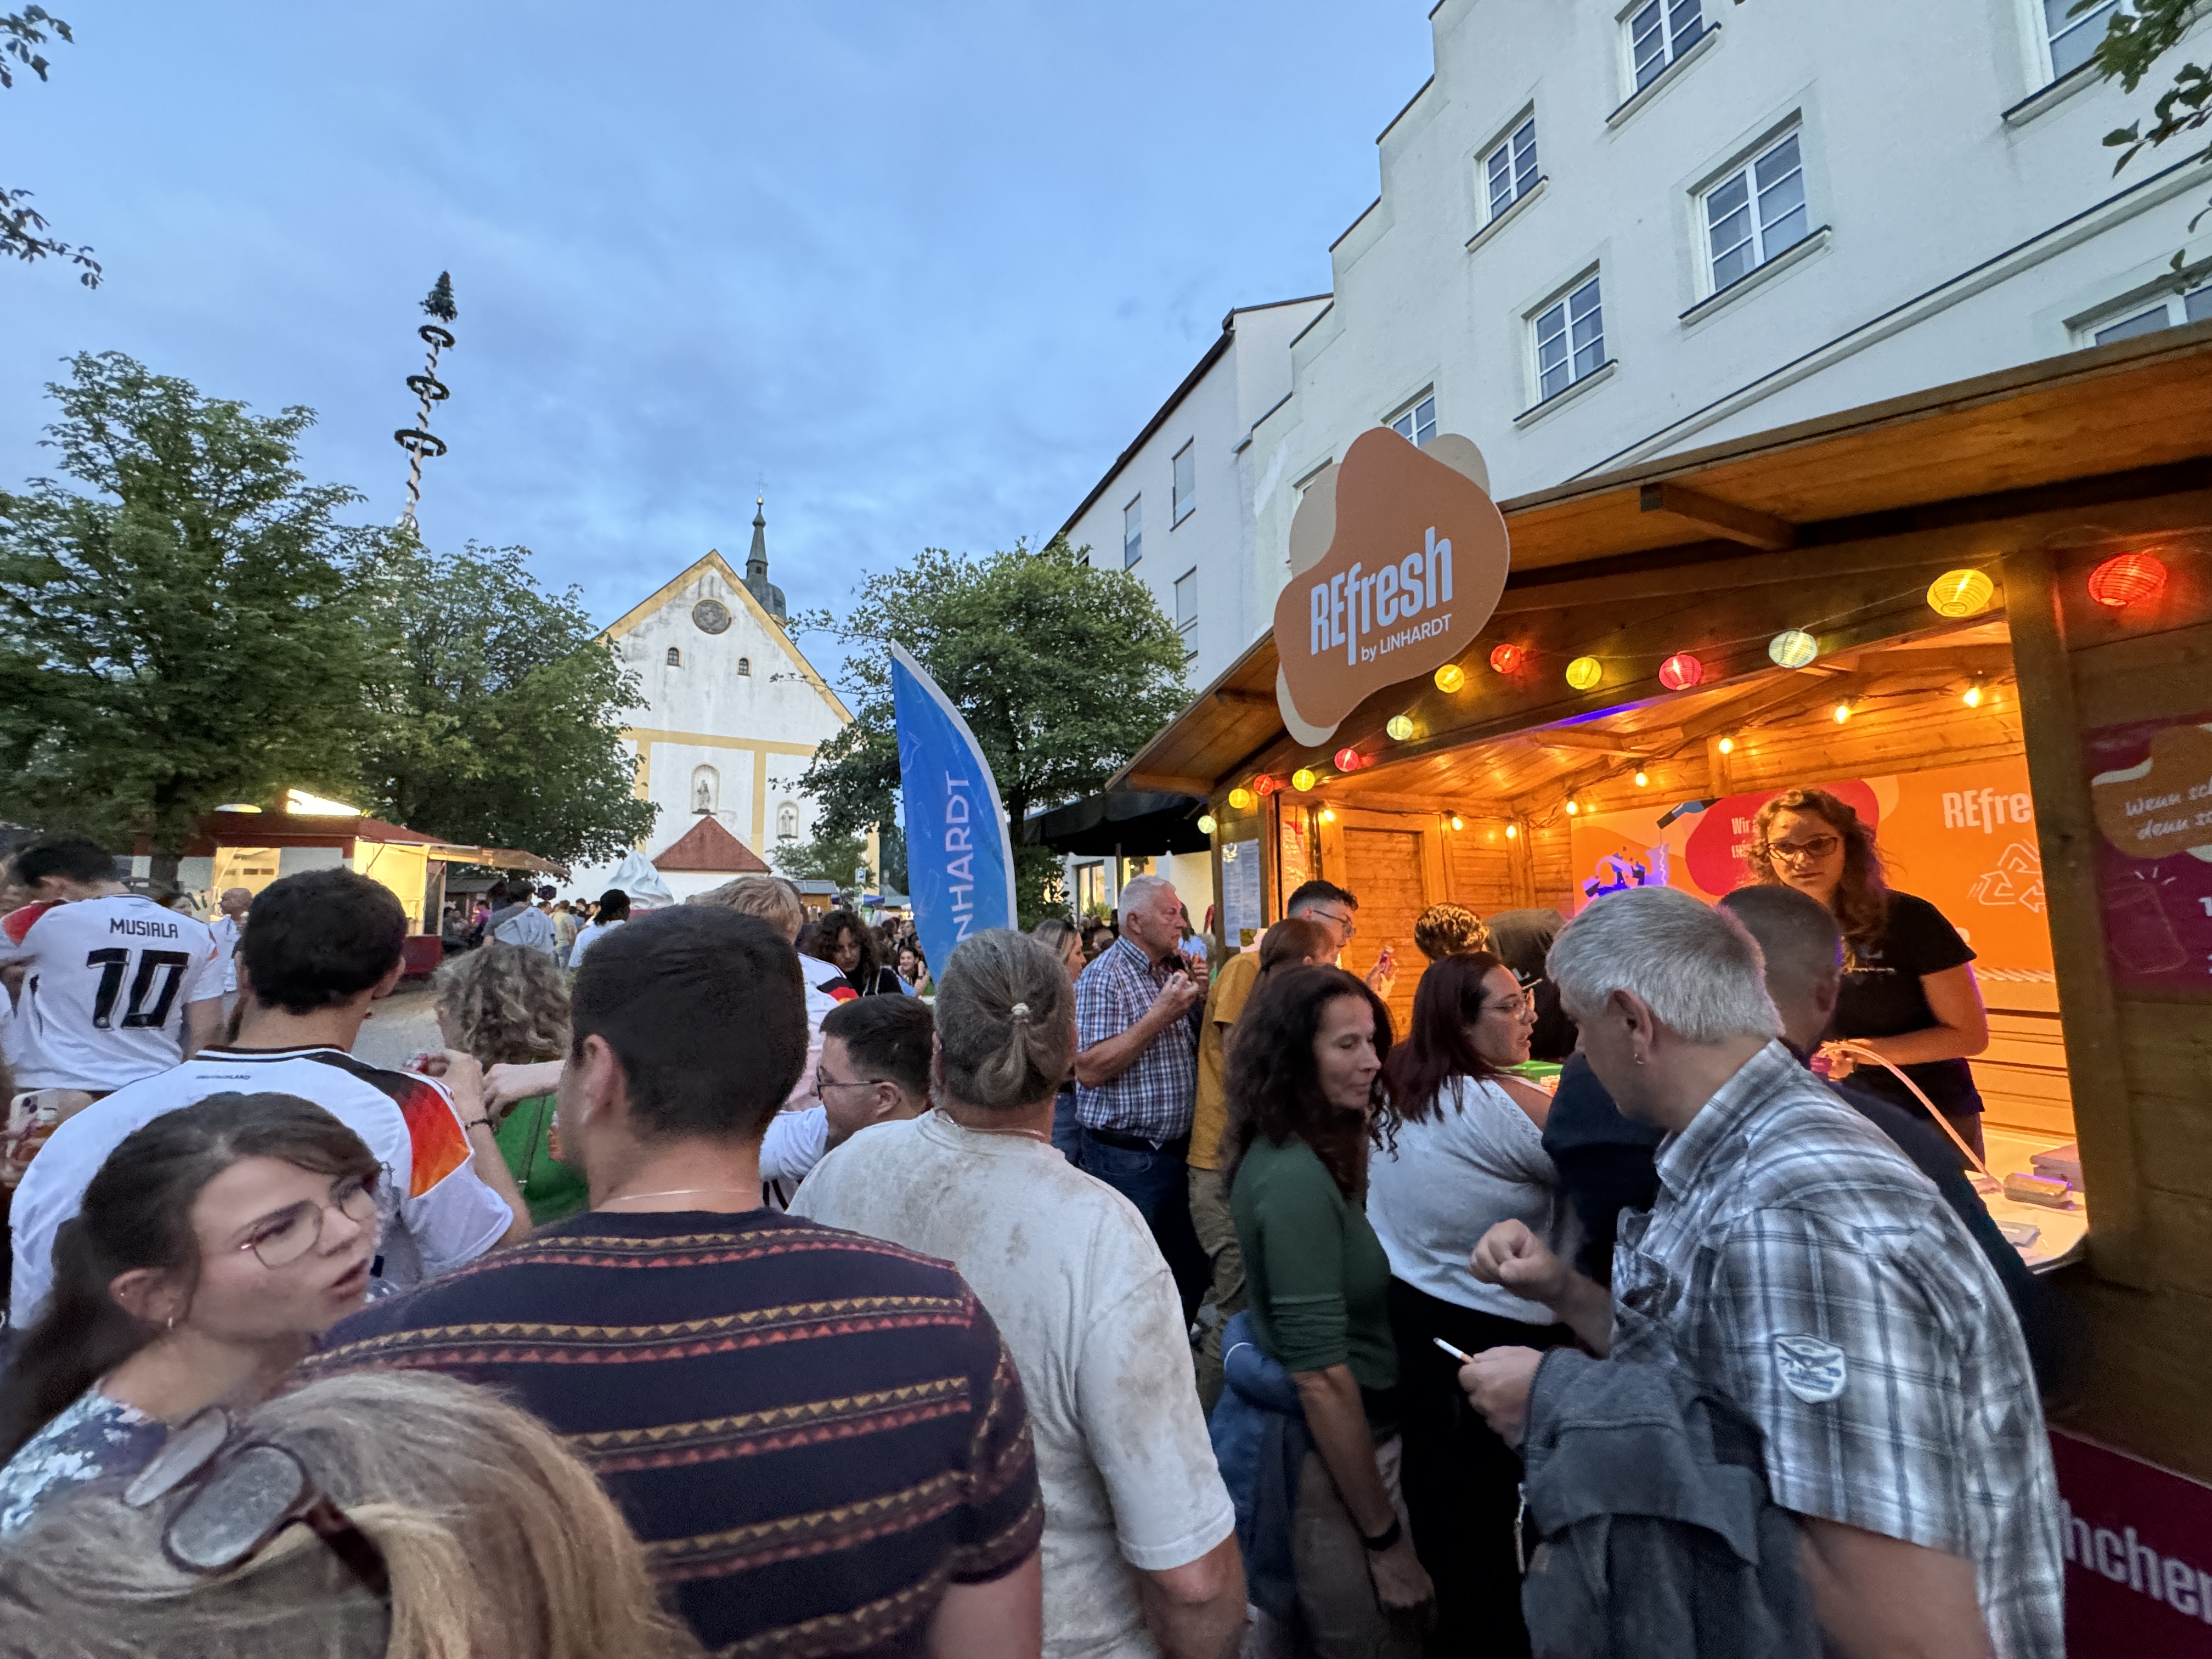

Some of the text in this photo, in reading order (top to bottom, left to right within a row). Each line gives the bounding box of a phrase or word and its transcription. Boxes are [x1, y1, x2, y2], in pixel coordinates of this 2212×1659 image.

[1311, 527, 1452, 665] REfresh
[1361, 613, 1452, 662] by LINHARDT
[1731, 816, 1751, 834] Wir
[1942, 787, 2032, 834] REfre
[945, 770, 974, 943] NHARDT
[110, 917, 179, 939] MUSIALA
[87, 947, 190, 1030] 10
